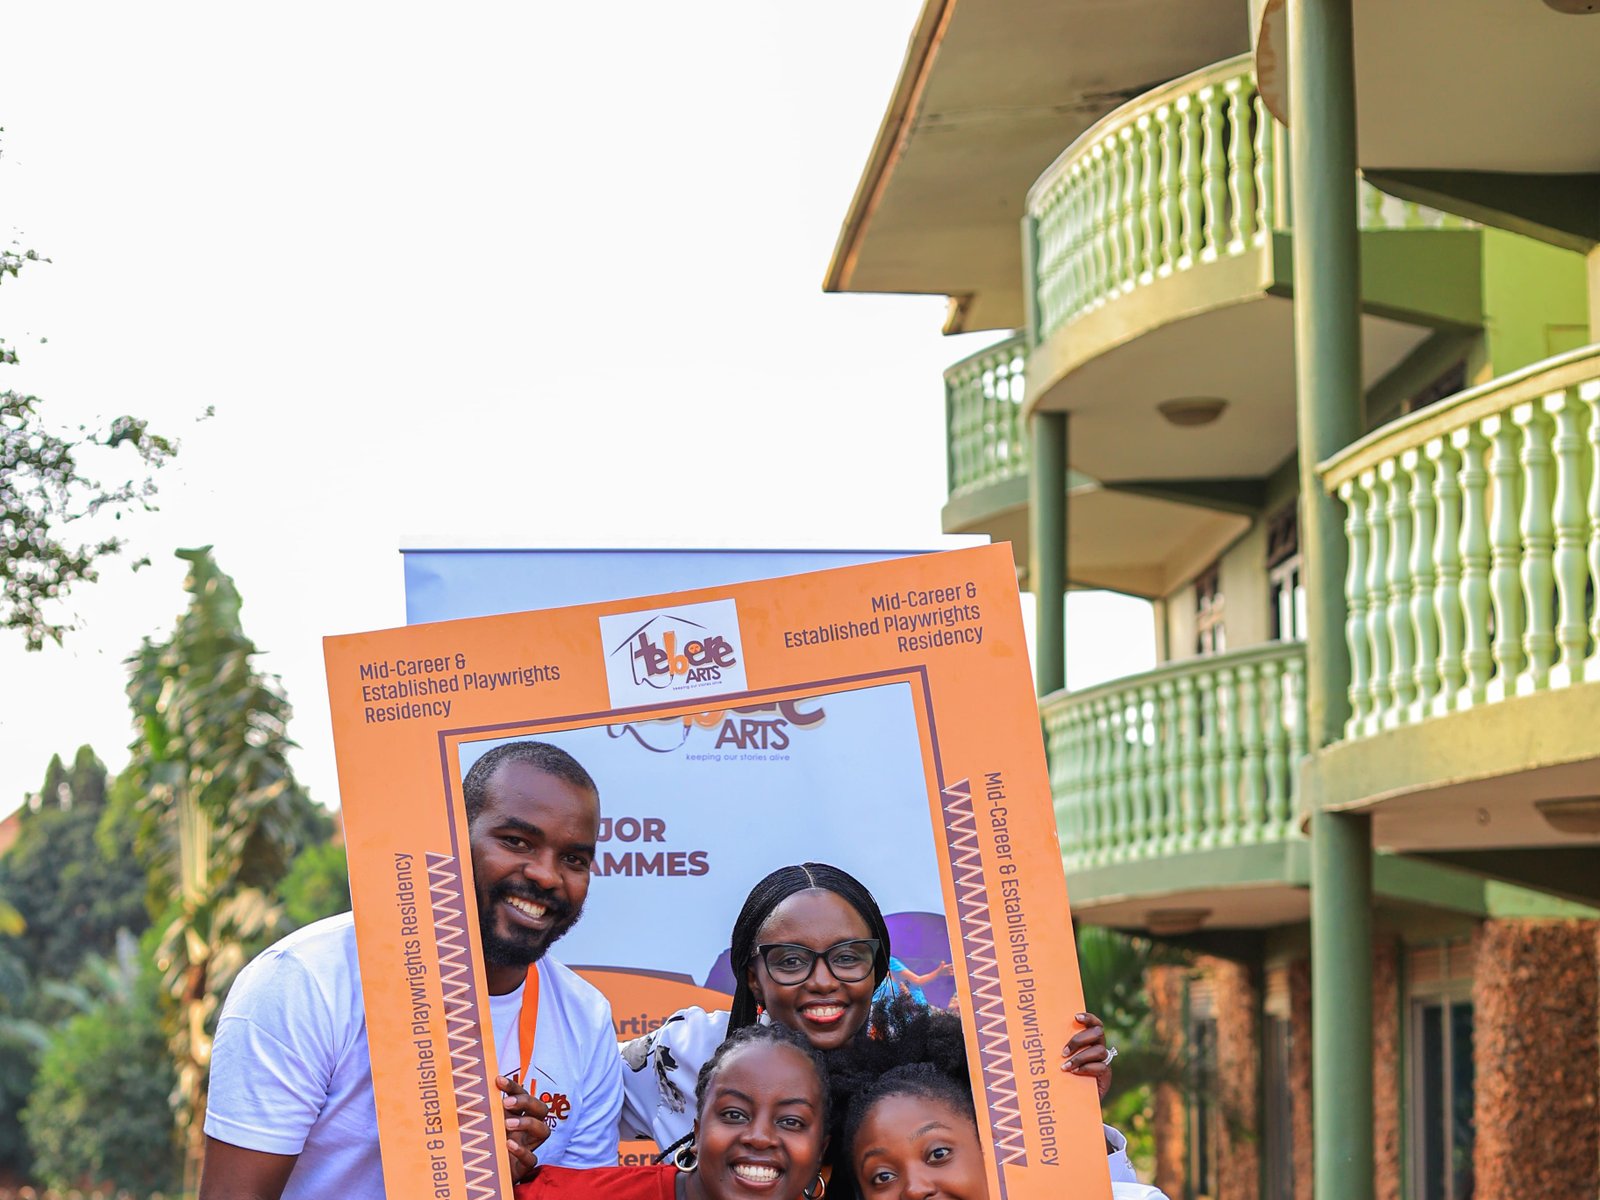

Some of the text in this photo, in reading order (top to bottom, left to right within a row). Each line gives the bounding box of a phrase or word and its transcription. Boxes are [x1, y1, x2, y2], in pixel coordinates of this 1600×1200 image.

[871, 582, 977, 613] Mid-Career &
[784, 605, 981, 648] Established Playwrights
[897, 626, 984, 653] Residency
[359, 653, 467, 681] Mid-Career &
[634, 630, 737, 677] tebere
[362, 664, 561, 702] Established Playwrights
[685, 665, 722, 684] ARTS
[365, 700, 452, 724] Residency
[714, 718, 790, 751] ARTS
[685, 753, 721, 762] keeping
[740, 753, 767, 761] stories
[769, 753, 791, 761] alive
[597, 817, 667, 843] JOR
[394, 852, 421, 937] Residency
[984, 772, 1060, 1167] Mid-Career & Established Playwrights Residency
[403, 939, 432, 1035] Playwrights
[413, 1039, 443, 1136] Established
[426, 1139, 445, 1151] &
